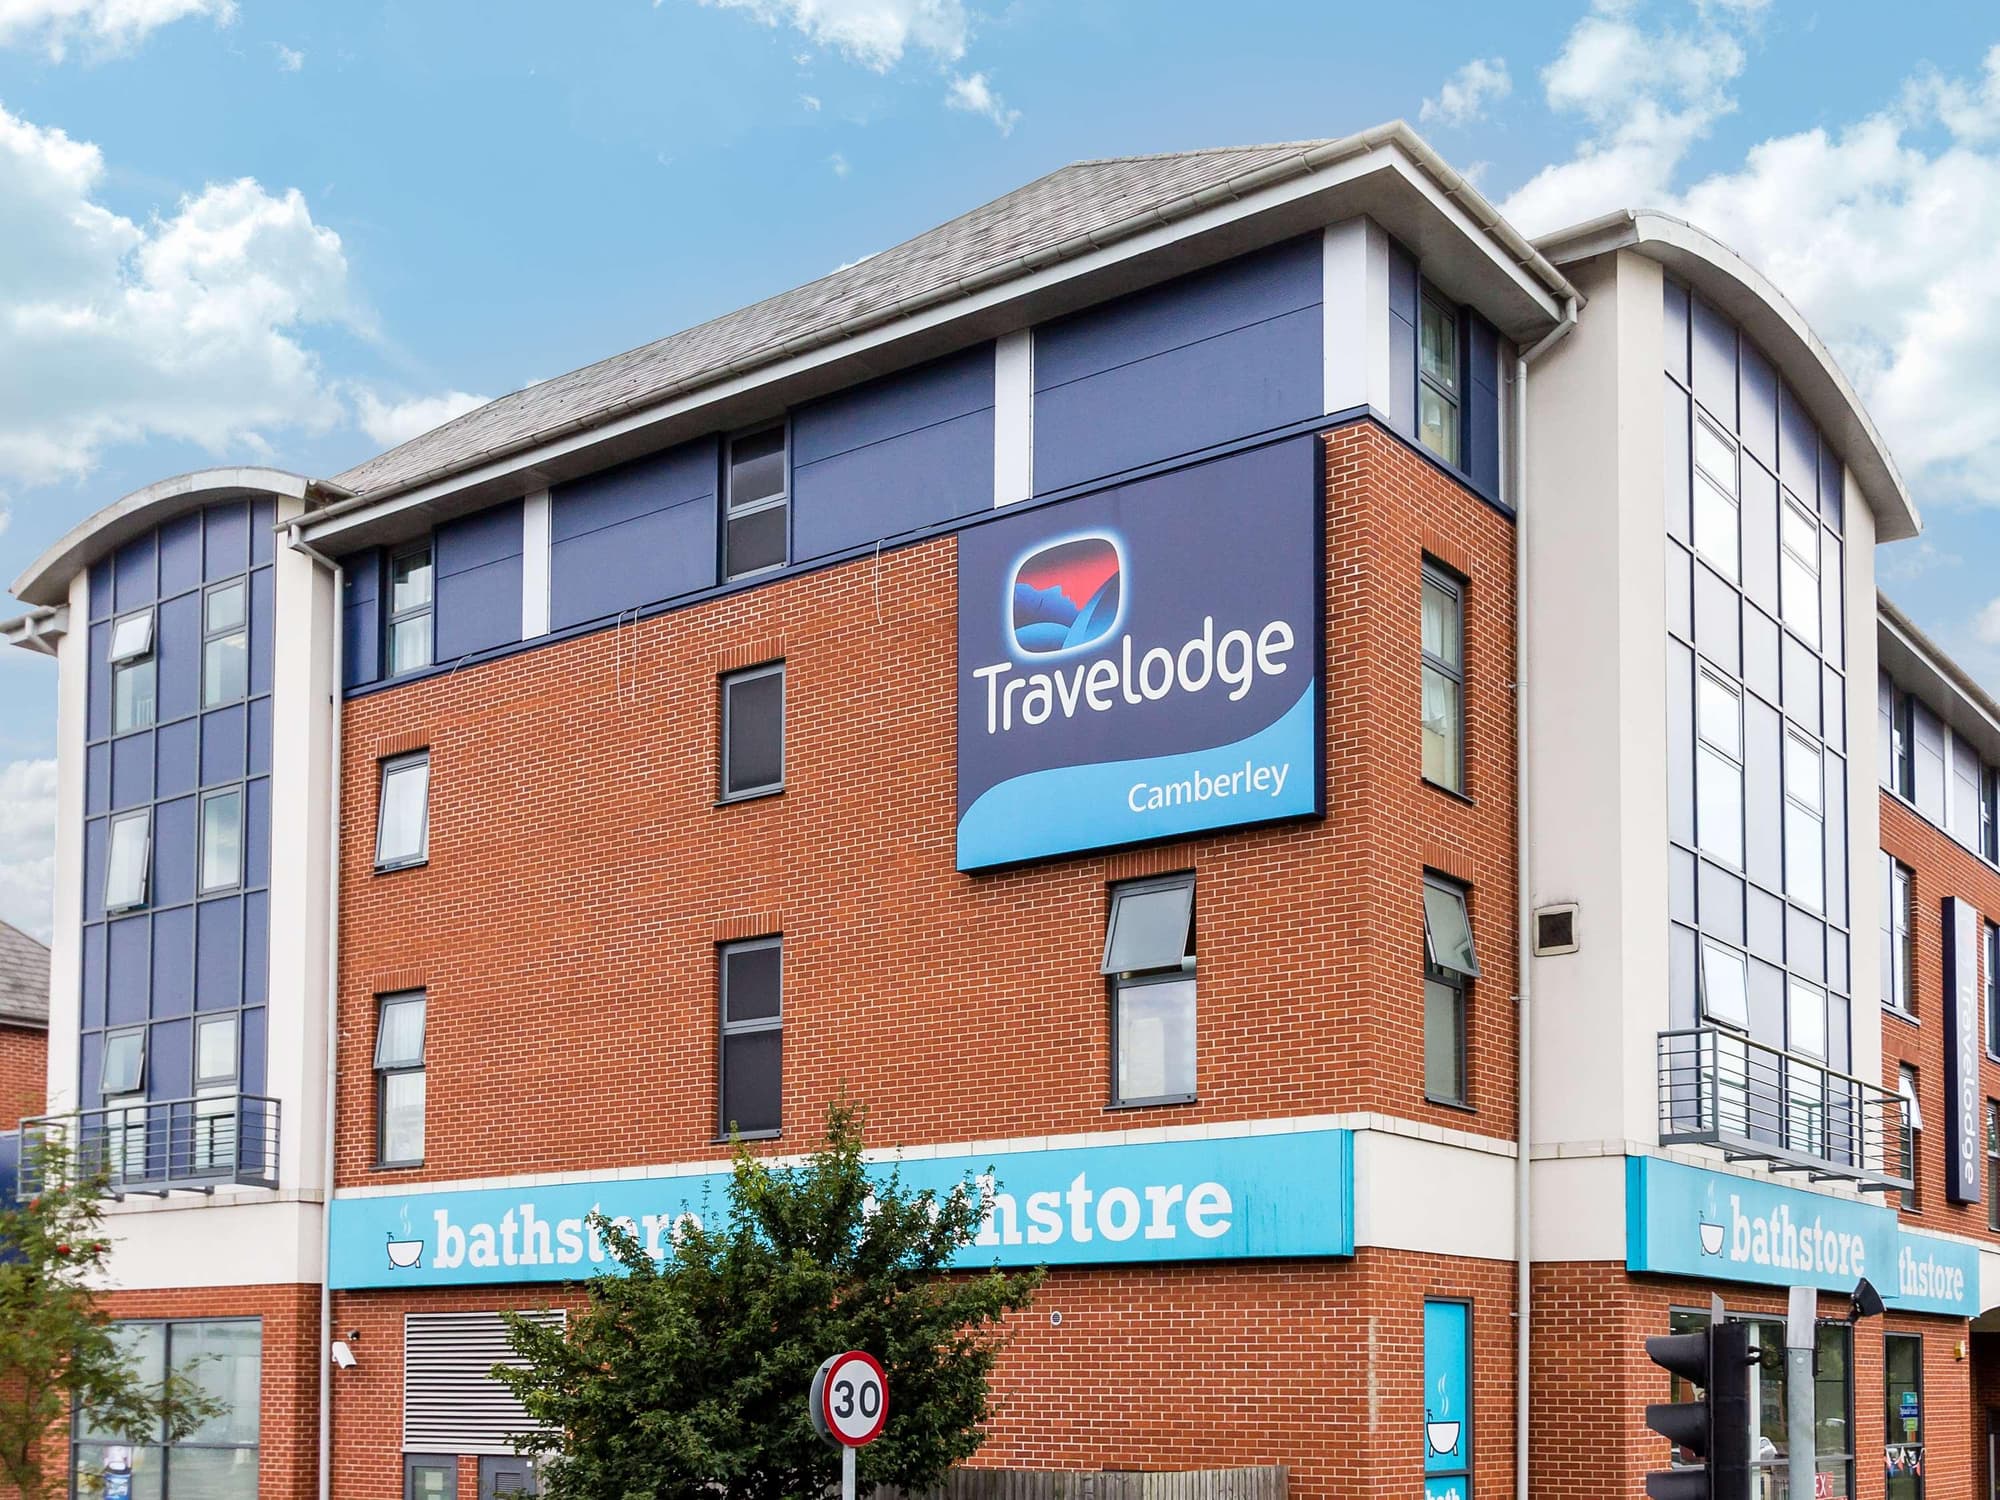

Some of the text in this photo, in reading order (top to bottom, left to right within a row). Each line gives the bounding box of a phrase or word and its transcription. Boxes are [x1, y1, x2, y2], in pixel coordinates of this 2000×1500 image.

[973, 616, 1294, 734] Travelodge
[1128, 761, 1289, 812] Camberley
[1961, 980, 1975, 1185] Travelodge
[1730, 1194, 1865, 1277] bathstore
[834, 1380, 881, 1418] 30
